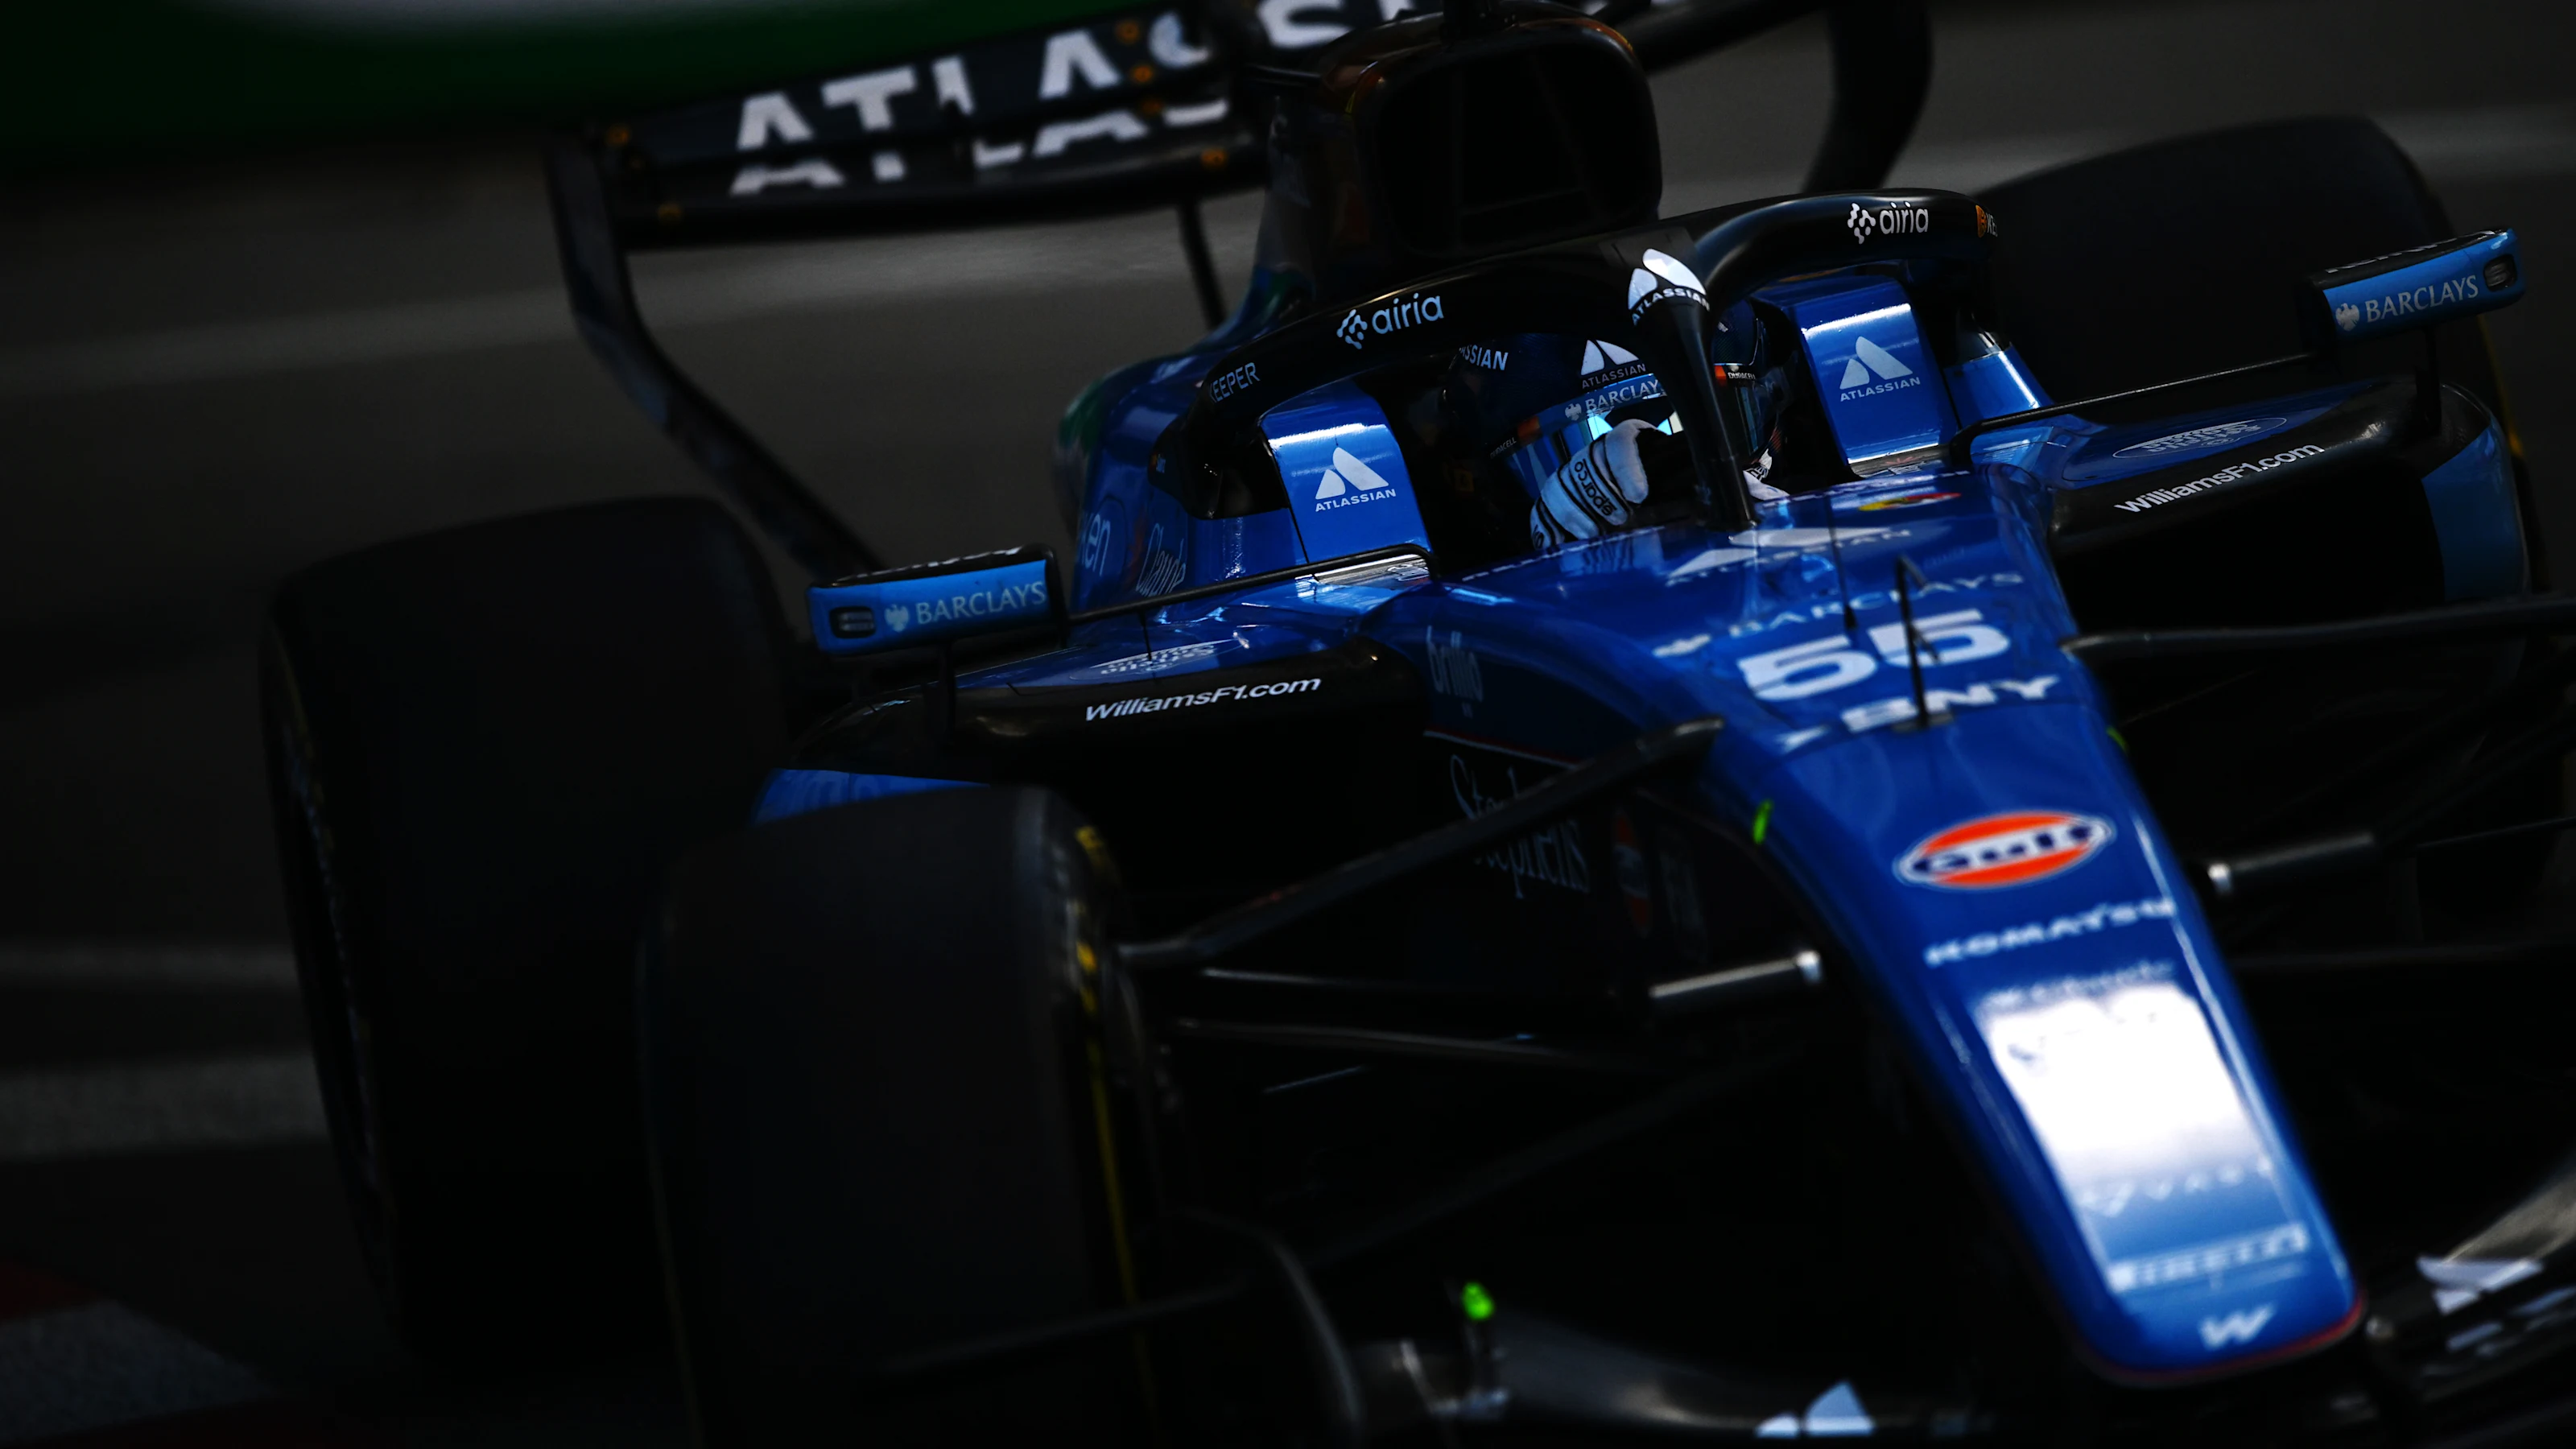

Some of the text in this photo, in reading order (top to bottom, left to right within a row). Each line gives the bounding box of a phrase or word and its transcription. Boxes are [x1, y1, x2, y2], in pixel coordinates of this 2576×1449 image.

[1879, 202, 1929, 235] airia
[1372, 292, 1444, 334] airia
[1632, 287, 1710, 327] ATLASSIAN
[2365, 275, 2479, 323] BARCLAYS
[1582, 363, 1646, 389] ATLASSIAN
[1840, 377, 1921, 402] ATLASSIAN
[1574, 459, 1616, 516] sparco
[2113, 441, 2325, 514] WilliamsF1.com
[1315, 489, 1396, 512] ATLASSIAN
[915, 580, 1046, 625] BARCLAYS
[1736, 608, 2011, 703] 55
[1084, 678, 1323, 722] WilliamsF1.com
[1912, 824, 2091, 873] Gulf
[1923, 898, 2175, 967] KOMATSU
